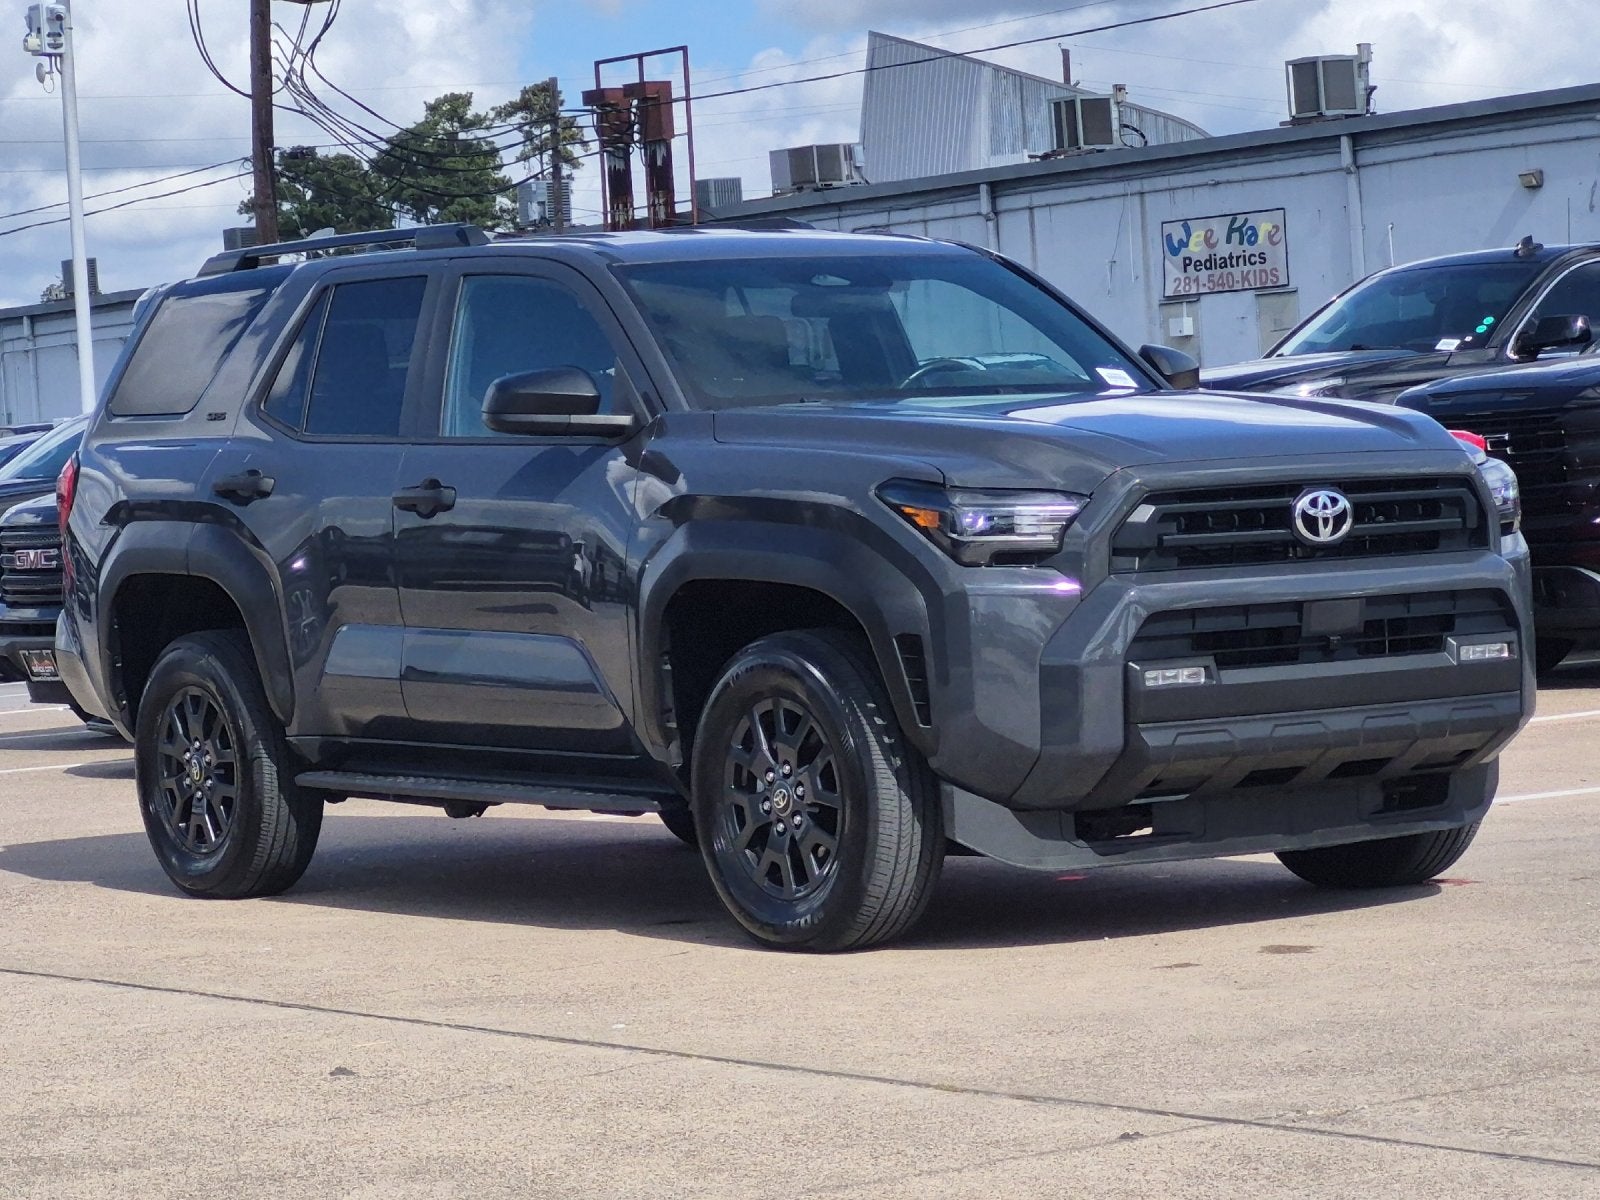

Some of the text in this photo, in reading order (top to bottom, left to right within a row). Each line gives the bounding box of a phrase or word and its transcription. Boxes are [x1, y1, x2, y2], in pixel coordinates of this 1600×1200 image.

[1165, 216, 1282, 257] Wee Kare
[1182, 250, 1267, 273] Pediatrics
[1173, 267, 1280, 294] 281-540-KIDS
[15, 548, 58, 569] GMC
